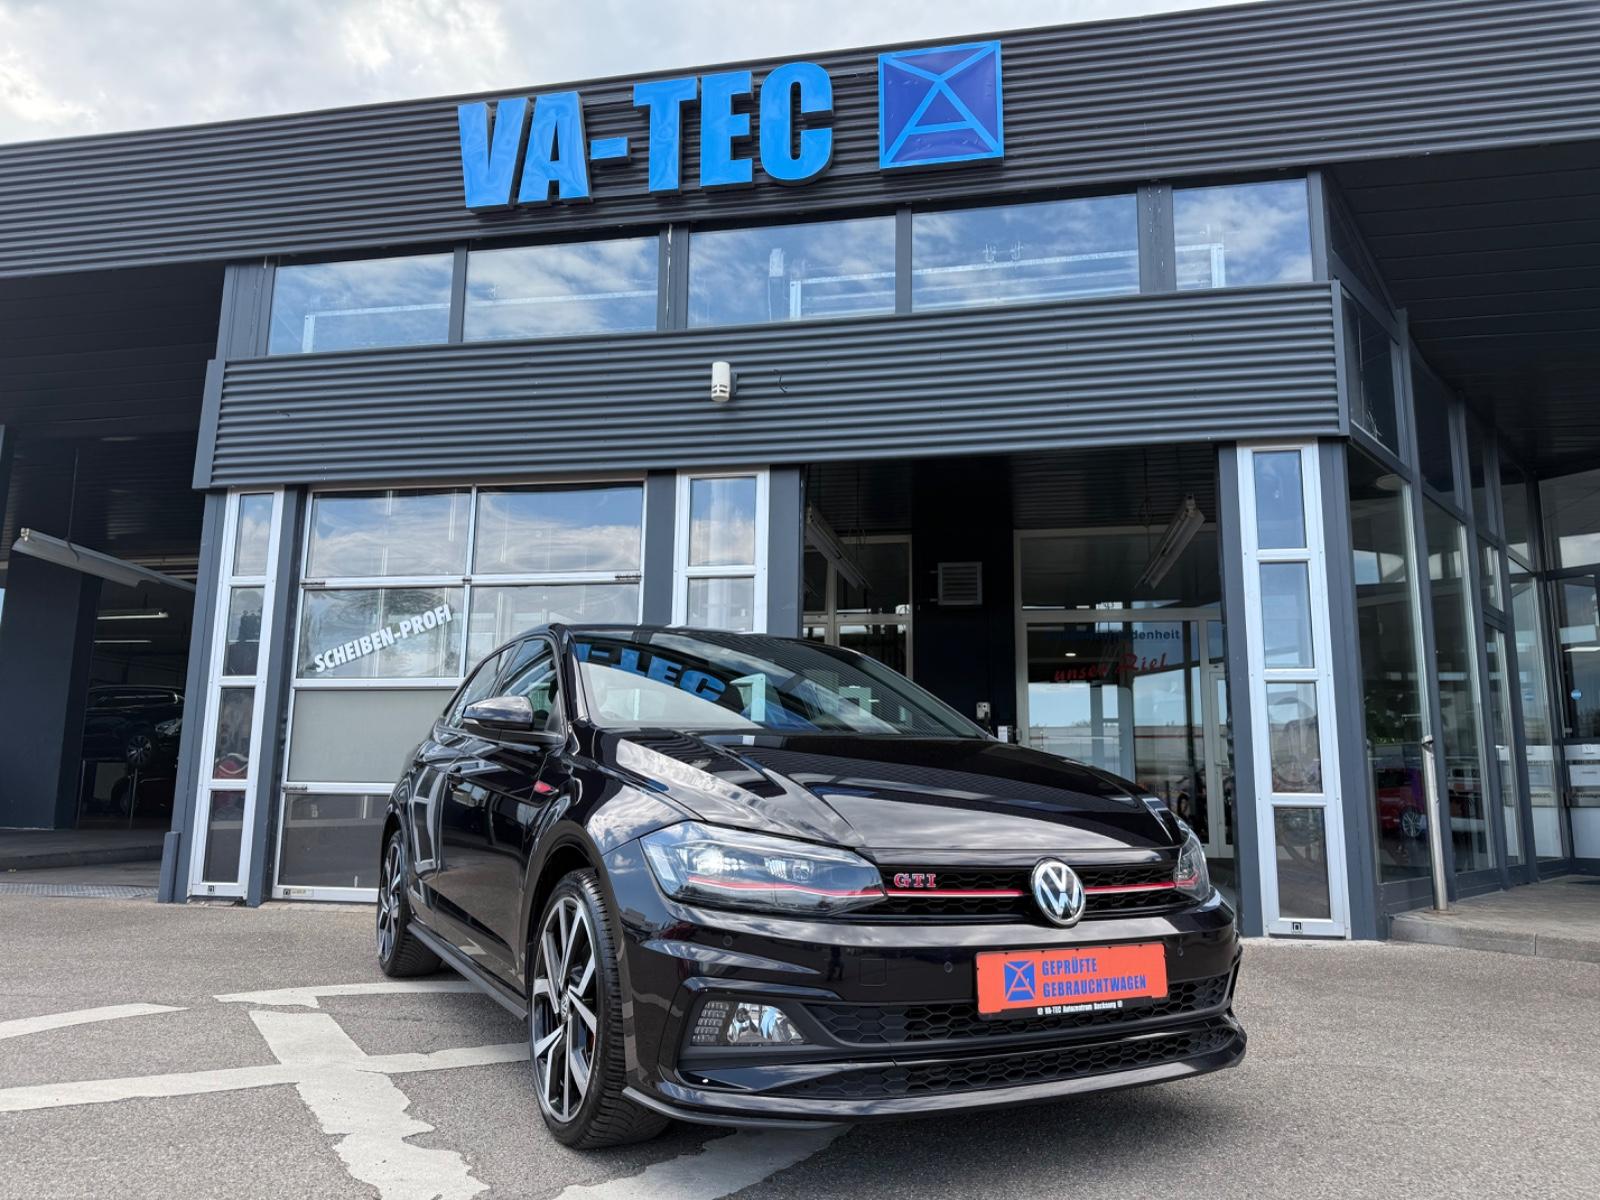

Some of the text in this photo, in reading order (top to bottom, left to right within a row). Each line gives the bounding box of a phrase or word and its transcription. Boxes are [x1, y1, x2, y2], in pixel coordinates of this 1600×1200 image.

[458, 62, 833, 209] VA-TEC
[314, 604, 454, 673] SCHEIBEN-PROFI
[893, 873, 937, 888] GTI
[1042, 957, 1098, 976] GEPRÜFTE
[1043, 975, 1147, 998] GEBRAUCHTWAGEN
